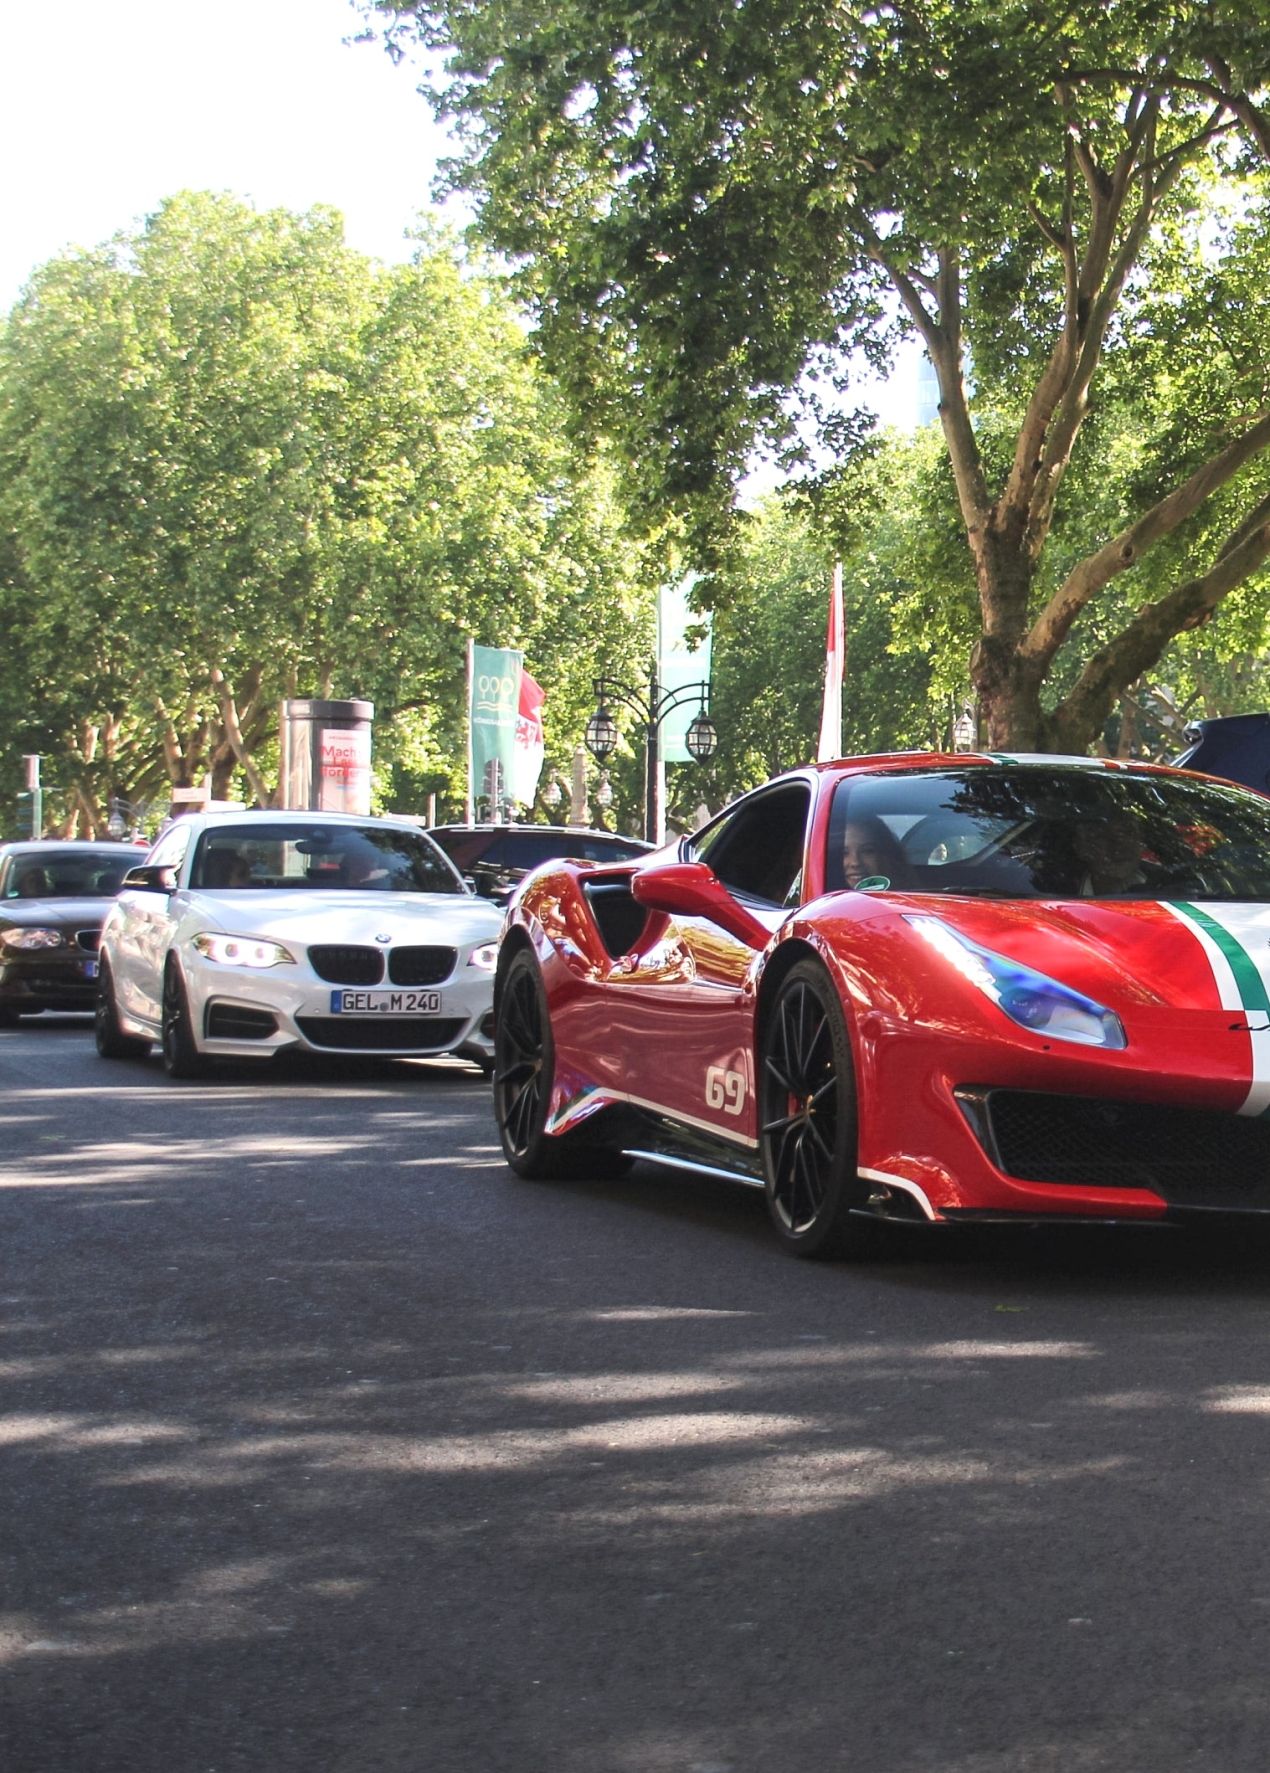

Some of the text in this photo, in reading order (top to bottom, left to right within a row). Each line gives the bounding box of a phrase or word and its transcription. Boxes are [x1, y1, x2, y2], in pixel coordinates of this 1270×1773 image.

[343, 994, 439, 1011] GEL M 240
[705, 1065, 746, 1116] 69
